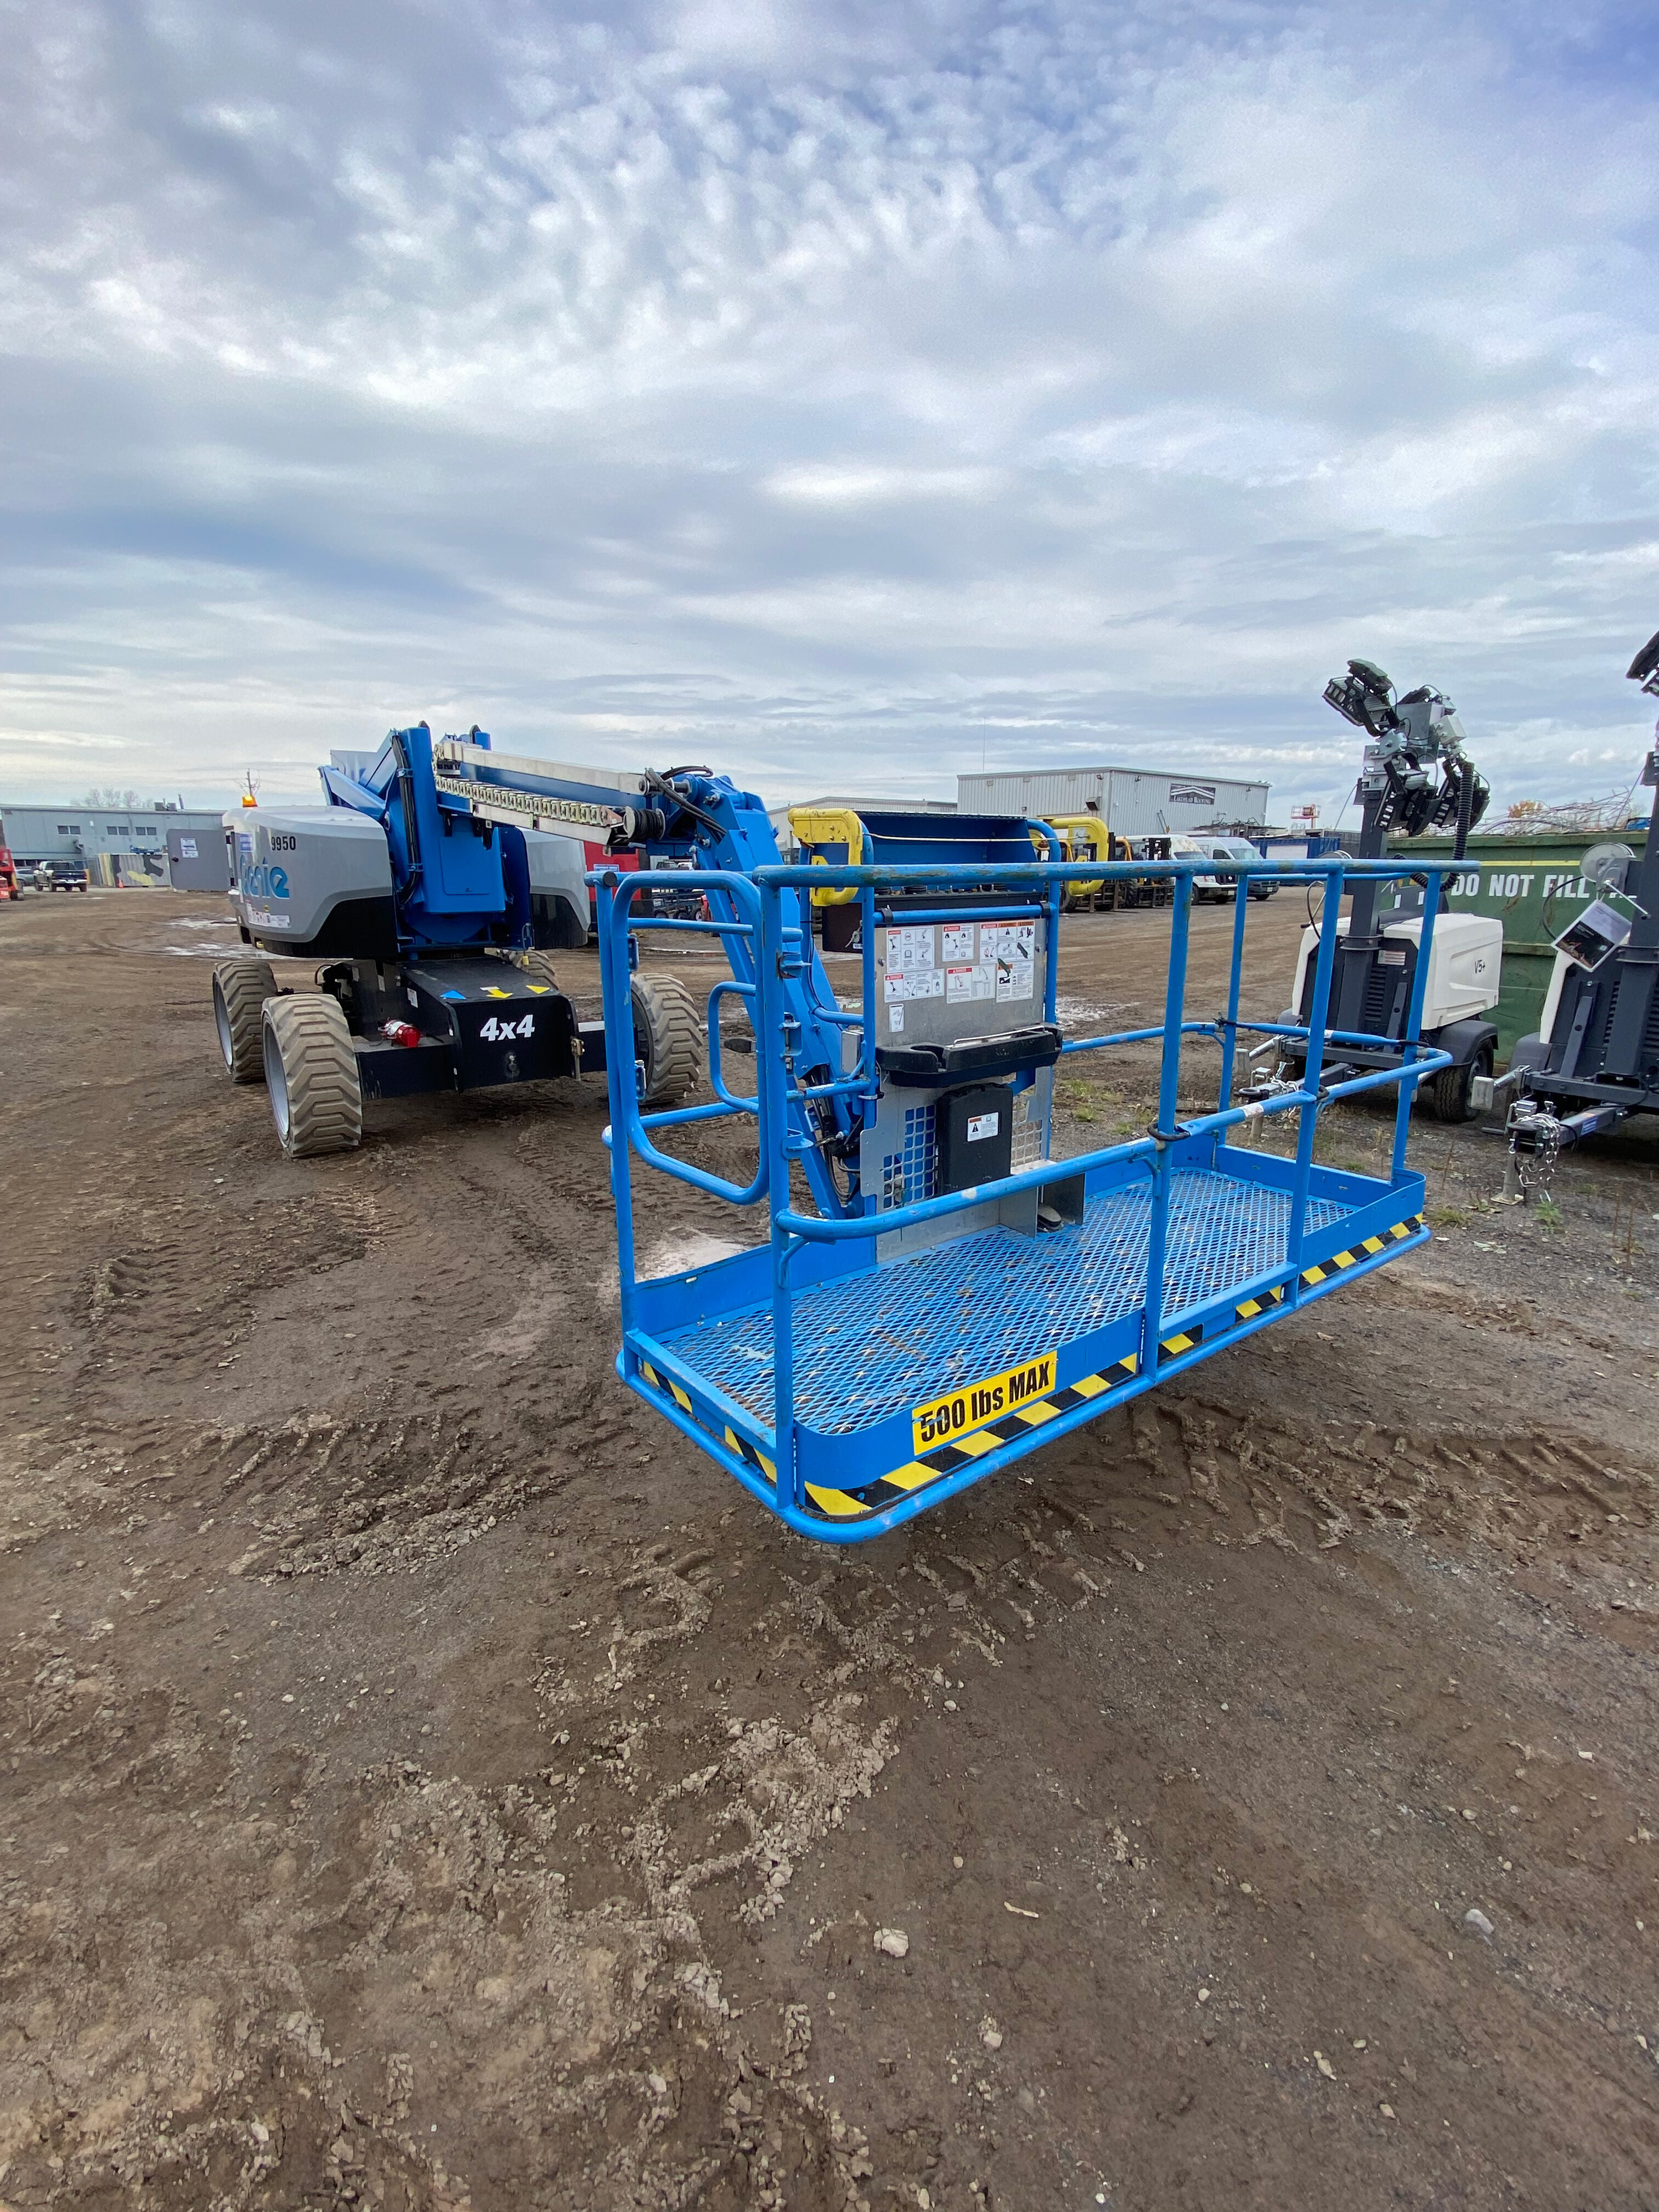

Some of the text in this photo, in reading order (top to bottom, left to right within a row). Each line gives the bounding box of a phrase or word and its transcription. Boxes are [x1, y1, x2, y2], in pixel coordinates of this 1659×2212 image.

[271, 836, 296, 851] 9950
[1451, 874, 1589, 899] DO NOT FILL
[480, 1014, 535, 1041] 4x4
[921, 1361, 1049, 1443] 500 lbs MAX
